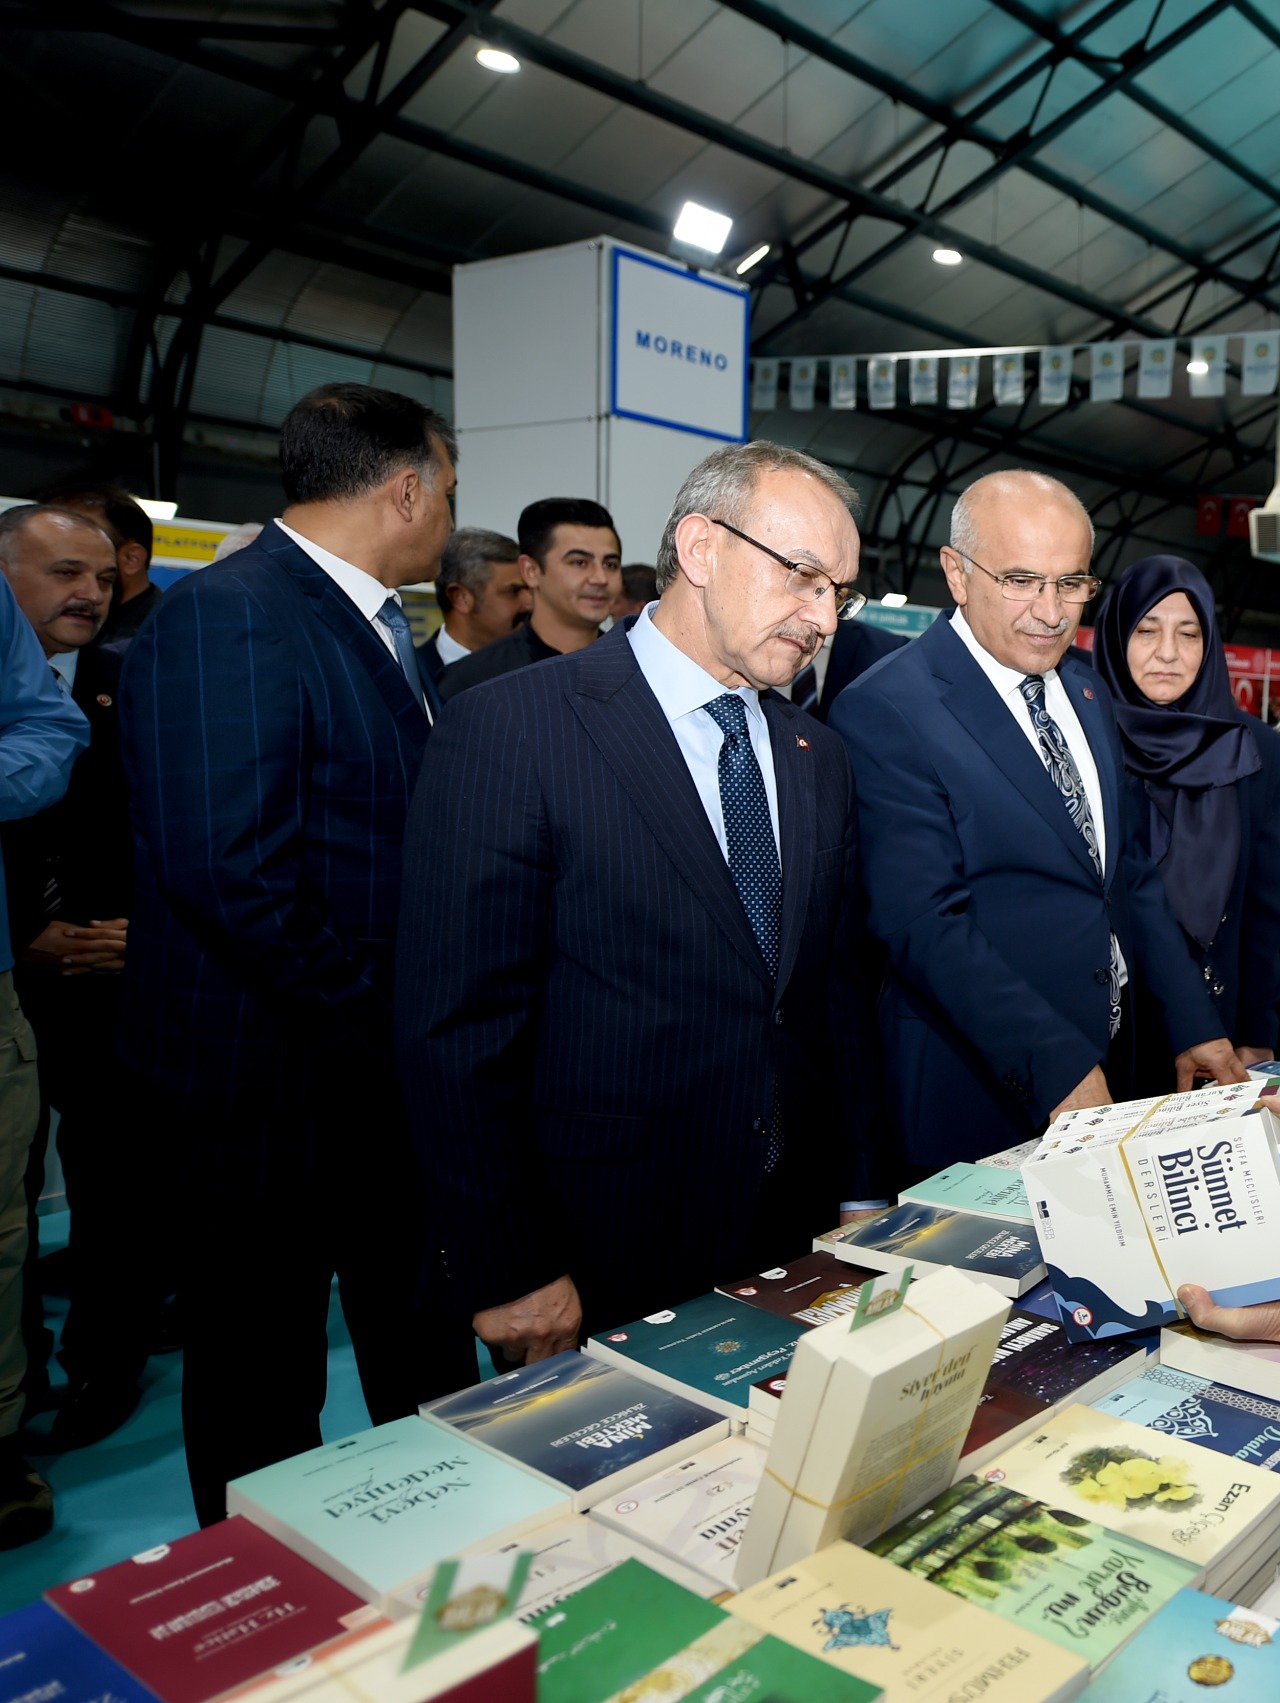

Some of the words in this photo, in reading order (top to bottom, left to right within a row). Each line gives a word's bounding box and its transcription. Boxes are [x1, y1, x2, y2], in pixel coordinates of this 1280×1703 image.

[636, 329, 728, 372] MORENO
[155, 536, 219, 549] PLATFOR
[1233, 1136, 1247, 1168] SUFFA
[1137, 1158, 1169, 1242] DERSLERİ
[1157, 1148, 1211, 1237] Bilinci
[1196, 1140, 1248, 1234] Sünnet
[920, 1368, 966, 1402] hyata
[575, 1412, 649, 1449] MEKTEBİ
[599, 1402, 648, 1429] ZİLHİCCE
[549, 1422, 602, 1447] GECELERİ
[593, 1421, 653, 1449] MİNA
[322, 1454, 471, 1522] Medeniyet
[1213, 1480, 1252, 1516] Ezan
